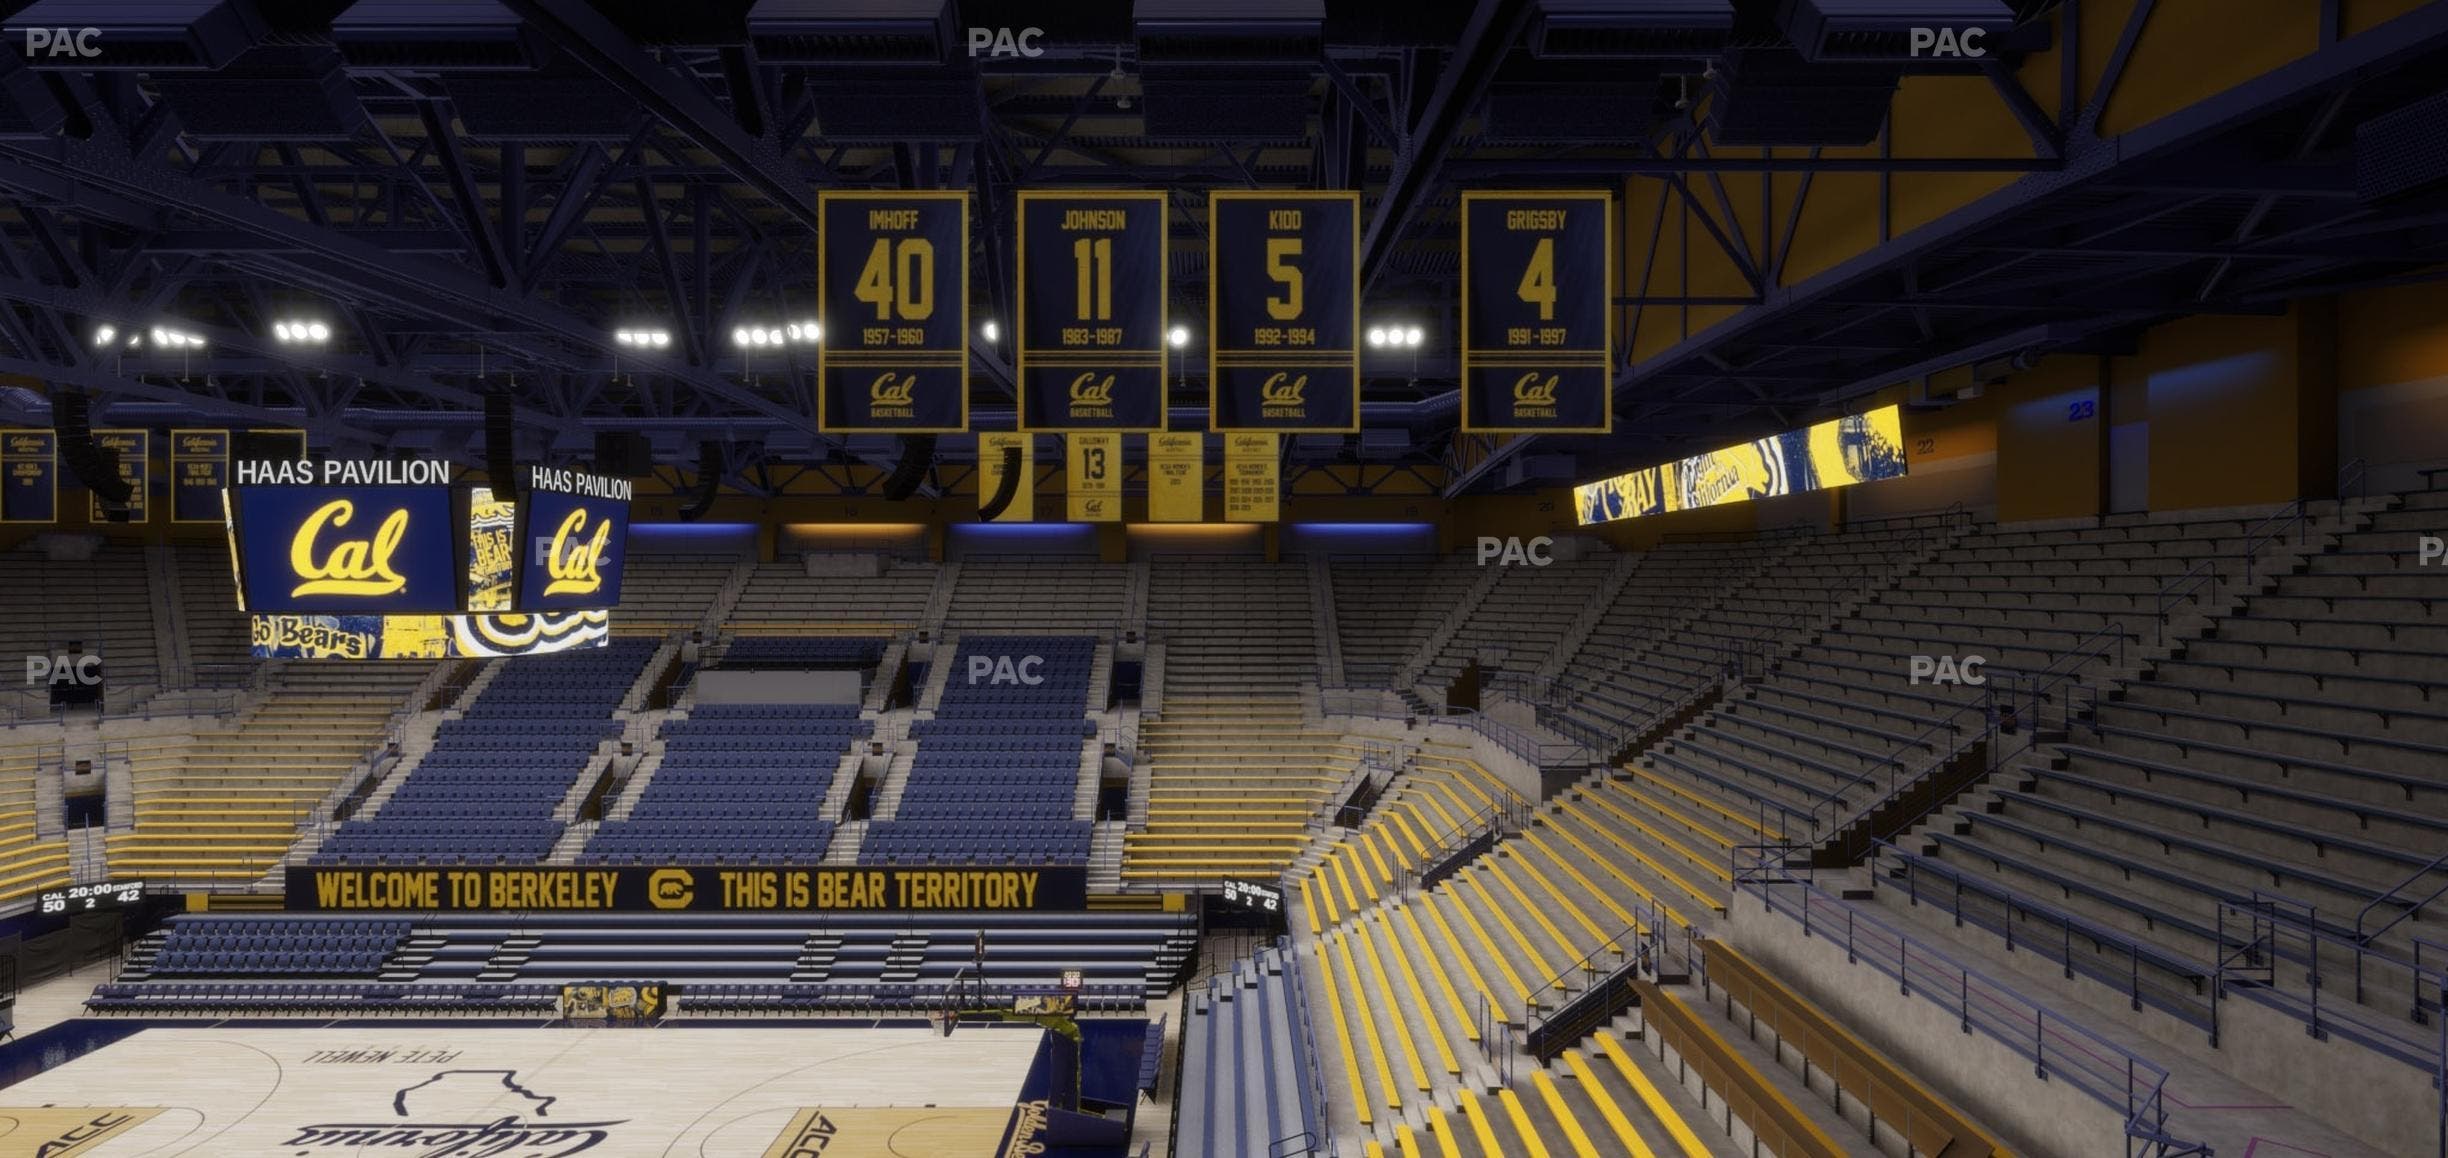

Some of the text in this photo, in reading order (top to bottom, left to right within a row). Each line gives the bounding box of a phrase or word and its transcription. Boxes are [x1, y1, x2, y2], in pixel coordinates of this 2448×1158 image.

[869, 210, 919, 230] IMHOFF
[1061, 210, 1126, 230] JOHNSON
[1269, 210, 1302, 230] KIDD
[1507, 210, 1567, 230] GRIGSBY
[854, 238, 934, 320] 40
[1074, 238, 1112, 320] 11
[1266, 238, 1303, 320] 5
[1517, 238, 1557, 320] 4
[863, 328, 924, 345] 1957-1960
[1061, 328, 1123, 345] 1983-1987
[1254, 328, 1315, 345] 1992-1994
[1507, 328, 1566, 345] 1991-1997
[870, 371, 917, 406] Cal
[1069, 371, 1116, 406] Cal
[1262, 371, 1308, 406] Cal
[1513, 371, 1560, 406] Cal
[871, 406, 915, 418] BASKETBALL
[1069, 406, 1115, 418] BASKETBALL
[1261, 406, 1306, 418] BASKETBALL
[1513, 406, 1558, 418] BASKETBALL
[2069, 400, 2095, 422] 23
[1917, 438, 1935, 455] 22
[238, 460, 314, 485] HAAS
[325, 460, 449, 485] PAVILION
[1083, 448, 1105, 479] 13
[532, 465, 632, 501] HAAS PAVILION
[291, 498, 409, 598] Cal
[472, 528, 507, 549] THIS IS
[476, 543, 511, 566] BEAR
[543, 508, 611, 597] Cal
[281, 617, 362, 656] Bears
[42, 892, 66, 901] CAL
[68, 883, 112, 899] 20:00
[316, 871, 620, 908] WELCOME TO BERKELEY
[719, 871, 1039, 908] THIS IS BEAR TERRITORY
[1224, 888, 1277, 911] 50 2 42
[1238, 881, 1262, 897] 20:00
[42, 889, 140, 913] 50 2 42
[303, 1050, 463, 1063] PETE NEWELL
